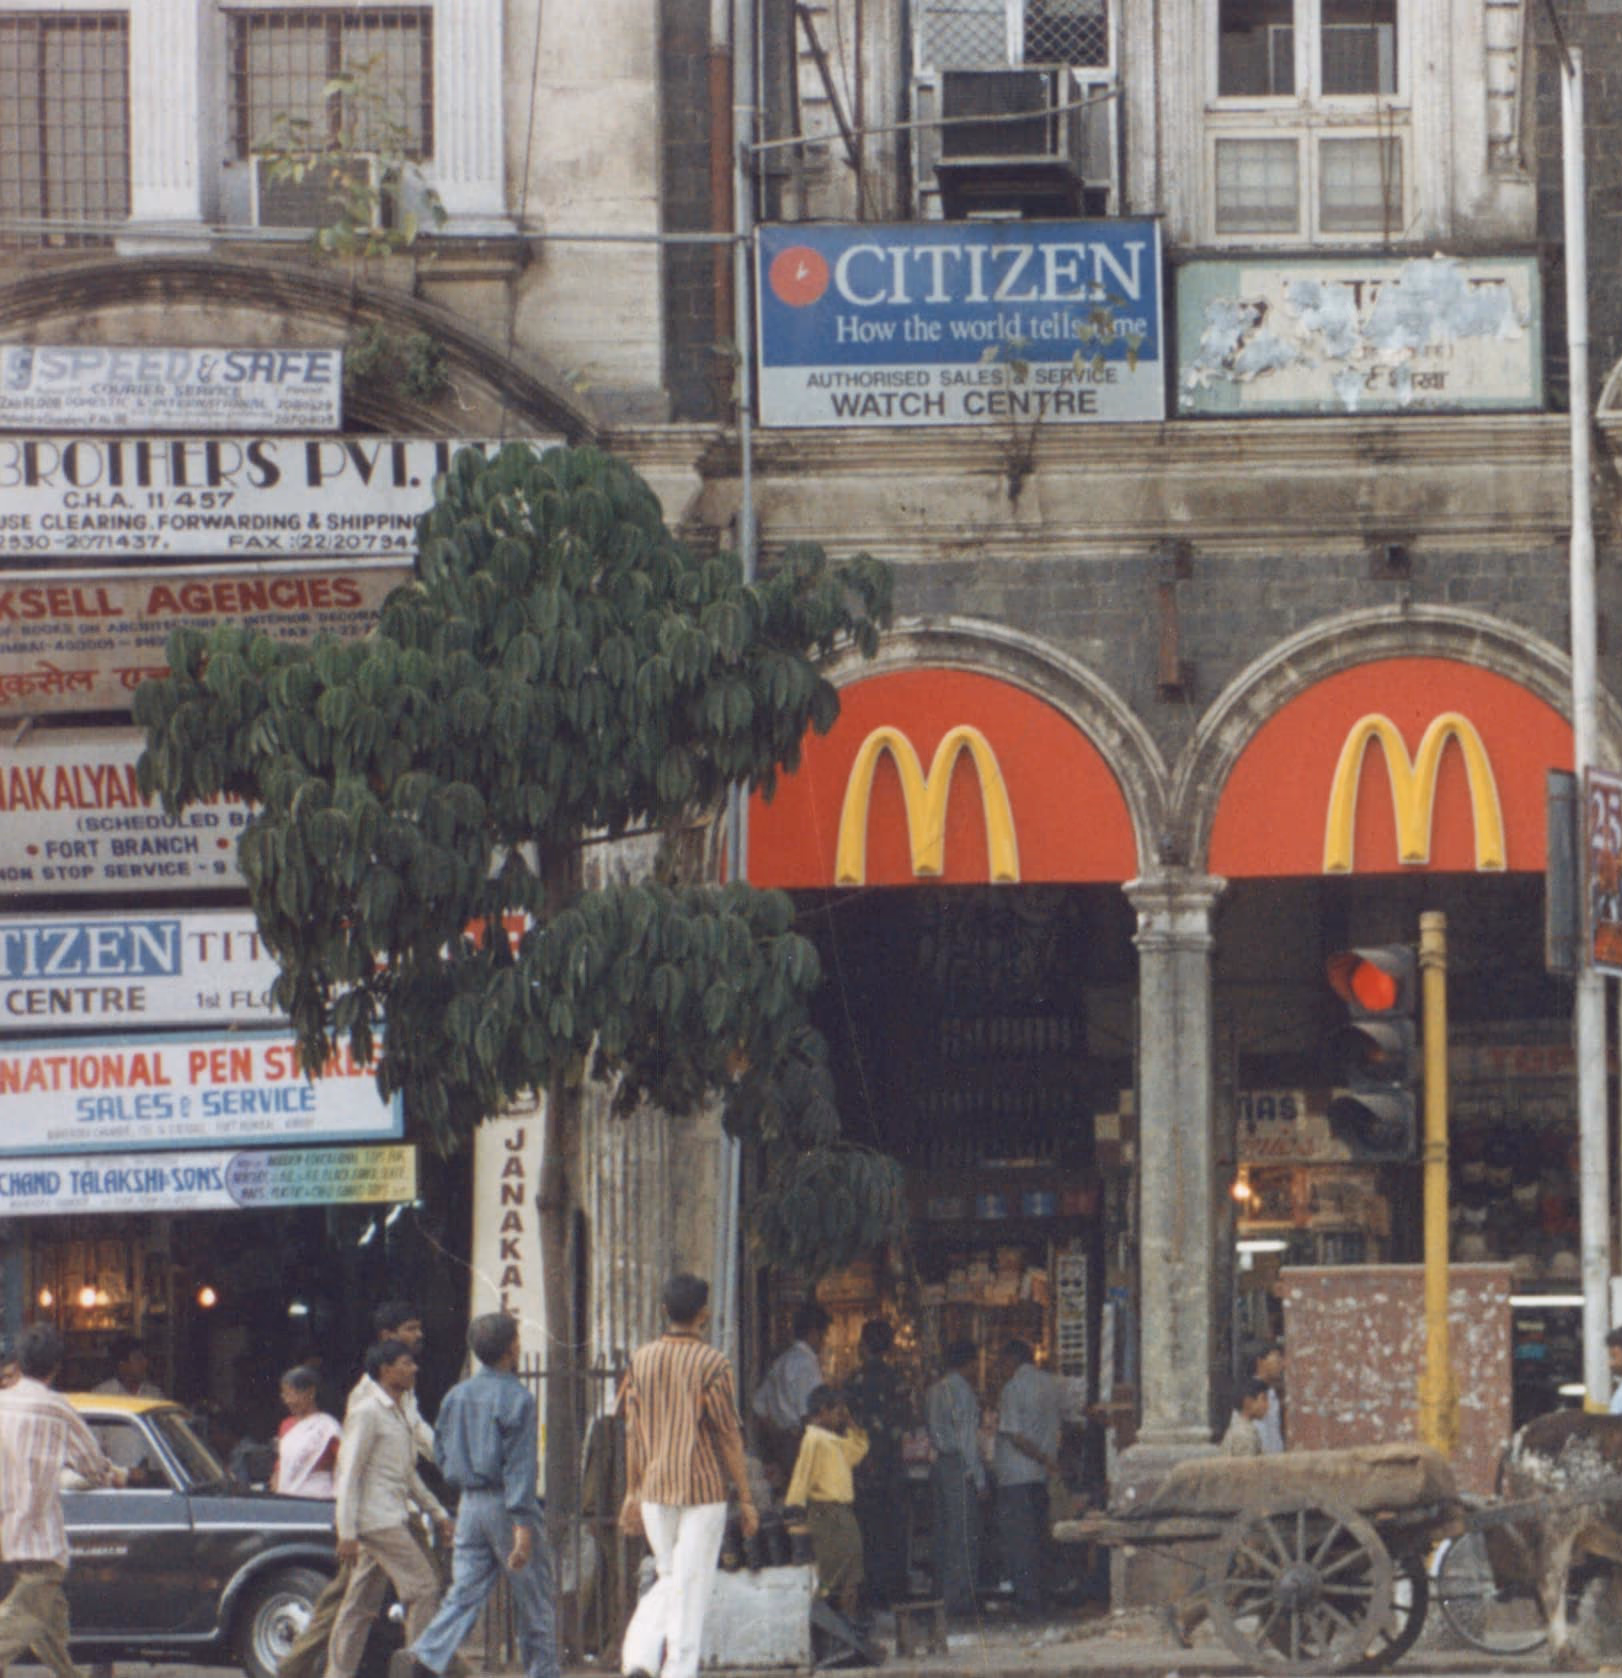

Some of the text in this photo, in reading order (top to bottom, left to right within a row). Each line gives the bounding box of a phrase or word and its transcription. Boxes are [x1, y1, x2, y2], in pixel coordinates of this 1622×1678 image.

[834, 242, 1145, 305] CITIZEN
[836, 315, 895, 343] How
[904, 313, 941, 341] the
[950, 312, 1020, 340] world
[1031, 312, 1081, 339] tells
[39, 350, 191, 383] SPEED
[223, 350, 332, 384] SAFE
[806, 370, 930, 388] AUTHORISED
[939, 369, 1001, 387] SALES
[1034, 367, 1118, 385] SERVICE
[175, 384, 242, 397] SERVICE
[831, 389, 1098, 417] WATCH CENTRE
[305, 440, 421, 487] PVT.
[158, 511, 300, 530] FORWARDING
[307, 511, 321, 529] &
[228, 534, 283, 549] FAX
[147, 576, 362, 613] AGENCIES
[76, 813, 220, 832] (SCHEDULED
[45, 835, 199, 859] FORT BRANCH
[41, 864, 94, 880] STOP
[103, 861, 192, 879] SERVICE
[5, 985, 146, 1016] CENTRE
[188, 1046, 254, 1085] PEN
[76, 1092, 173, 1122] SALES
[202, 1086, 316, 1117] SERVICE
[69, 1167, 164, 1195] TALAKSHI
[171, 1165, 224, 1192] SONS
